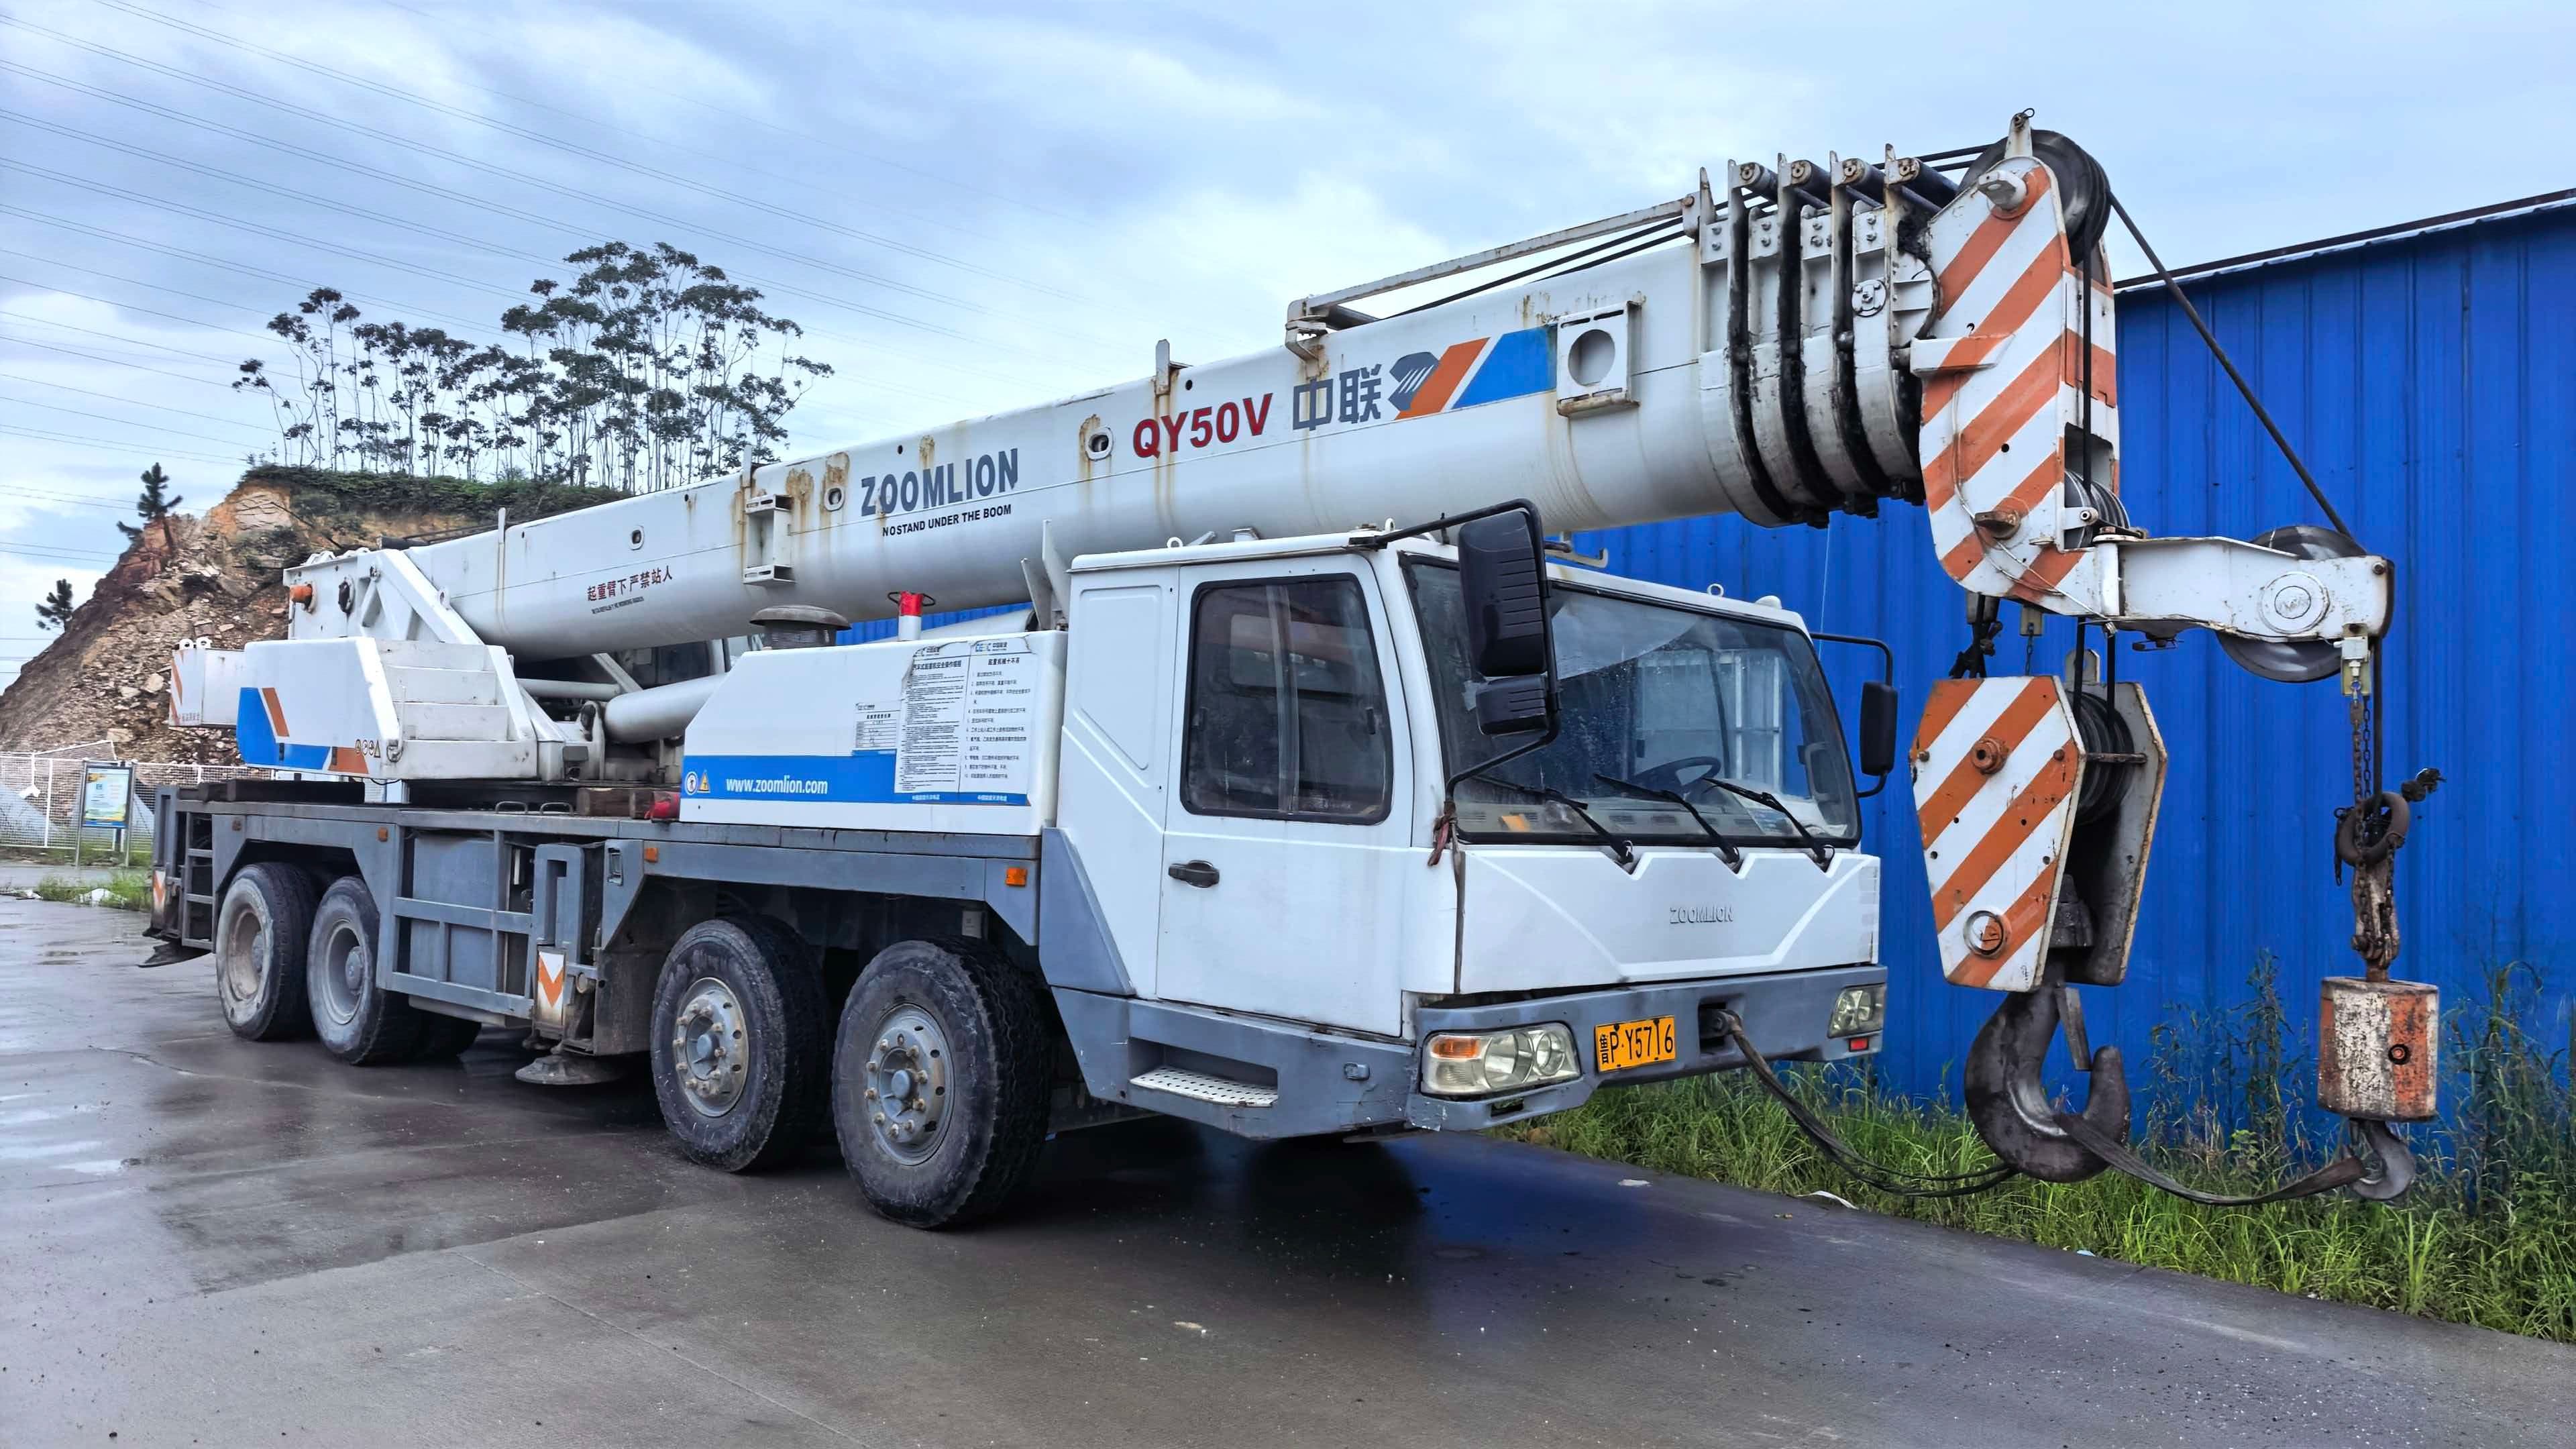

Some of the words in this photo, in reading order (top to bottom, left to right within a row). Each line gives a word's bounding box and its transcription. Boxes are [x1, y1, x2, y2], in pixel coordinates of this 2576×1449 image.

[1292, 363, 1381, 431] 中联
[1132, 392, 1273, 459] QY50V
[861, 447, 1018, 517] ZOOMLION
[928, 514, 959, 529] UNDER
[961, 510, 981, 523] THE
[983, 504, 1012, 519] BOOM
[587, 565, 673, 602] 起重臂下严禁站人
[726, 775, 828, 794] www.zoomlion.com
[1669, 906, 1733, 924] ZOOMLION
